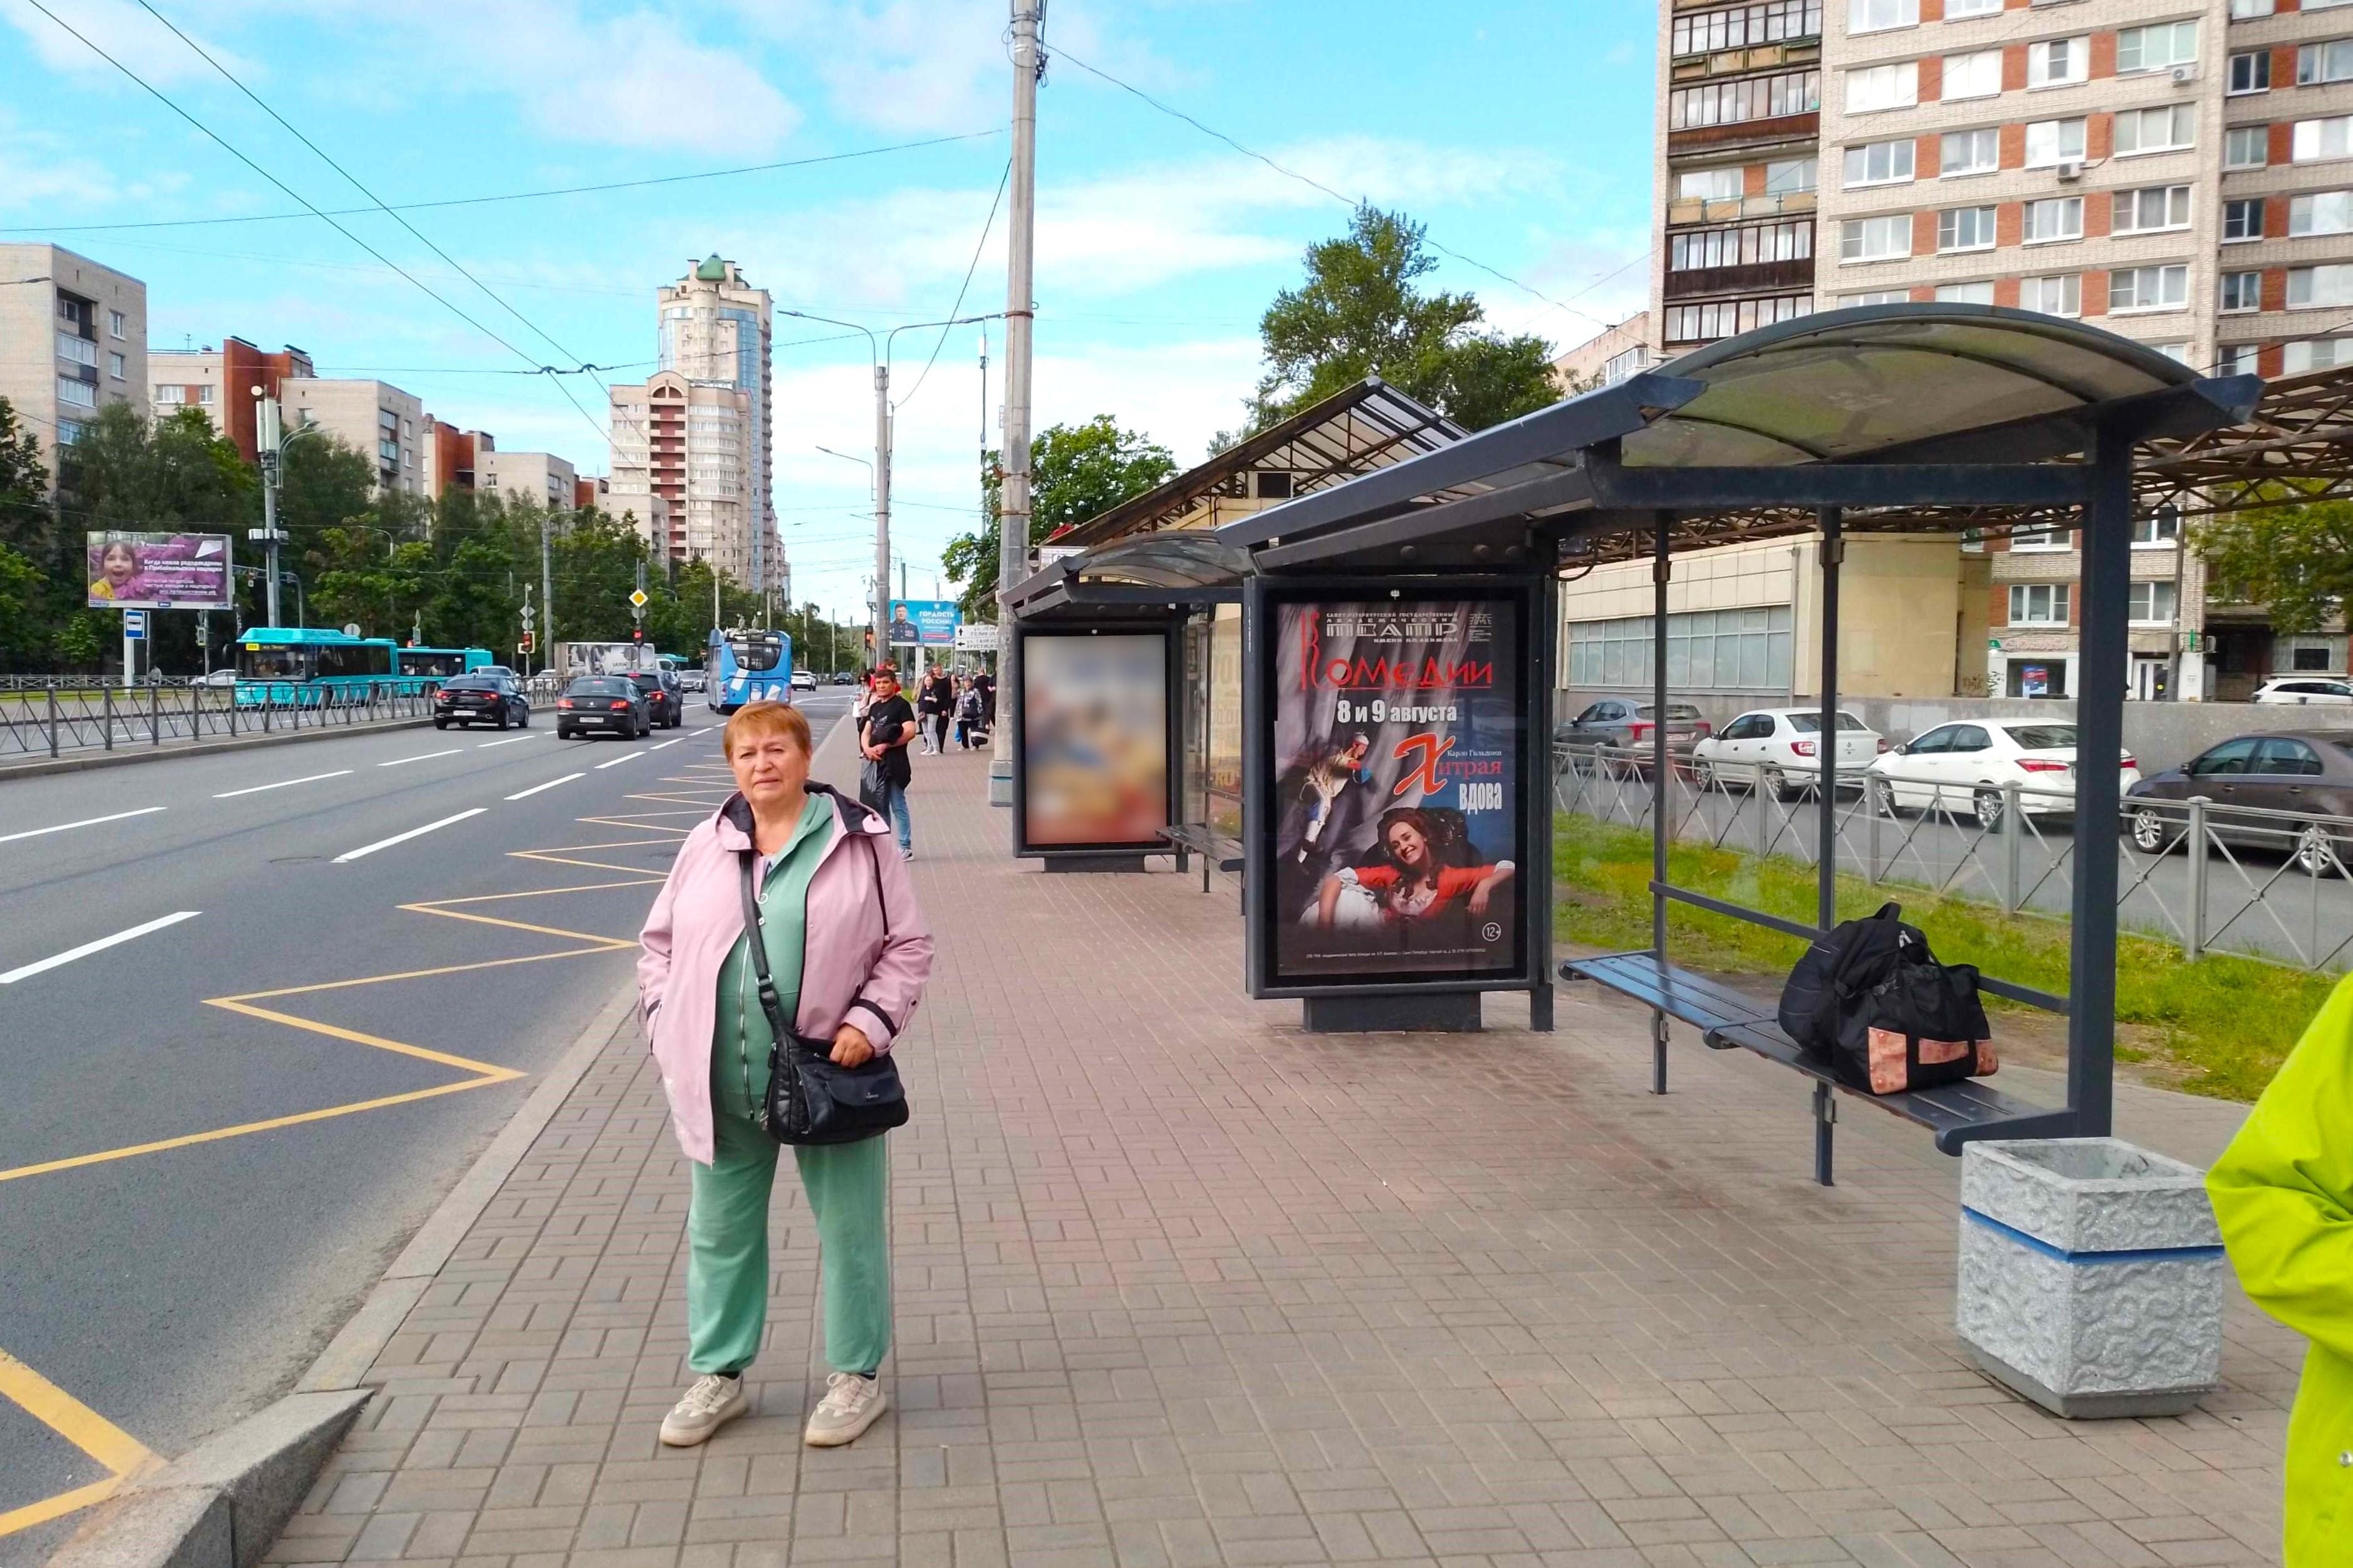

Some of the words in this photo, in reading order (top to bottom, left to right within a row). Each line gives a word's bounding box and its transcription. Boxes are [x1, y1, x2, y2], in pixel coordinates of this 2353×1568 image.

[1326, 623, 1458, 637] ТЕАТР
[1337, 699, 1351, 723] 8
[1355, 706, 1368, 723] и
[1372, 699, 1385, 723] 9
[1390, 705, 1457, 723] августа
[1446, 749, 1467, 757] Карло
[1392, 732, 1502, 796] Хитрая
[1486, 926, 1501, 938] 12+
